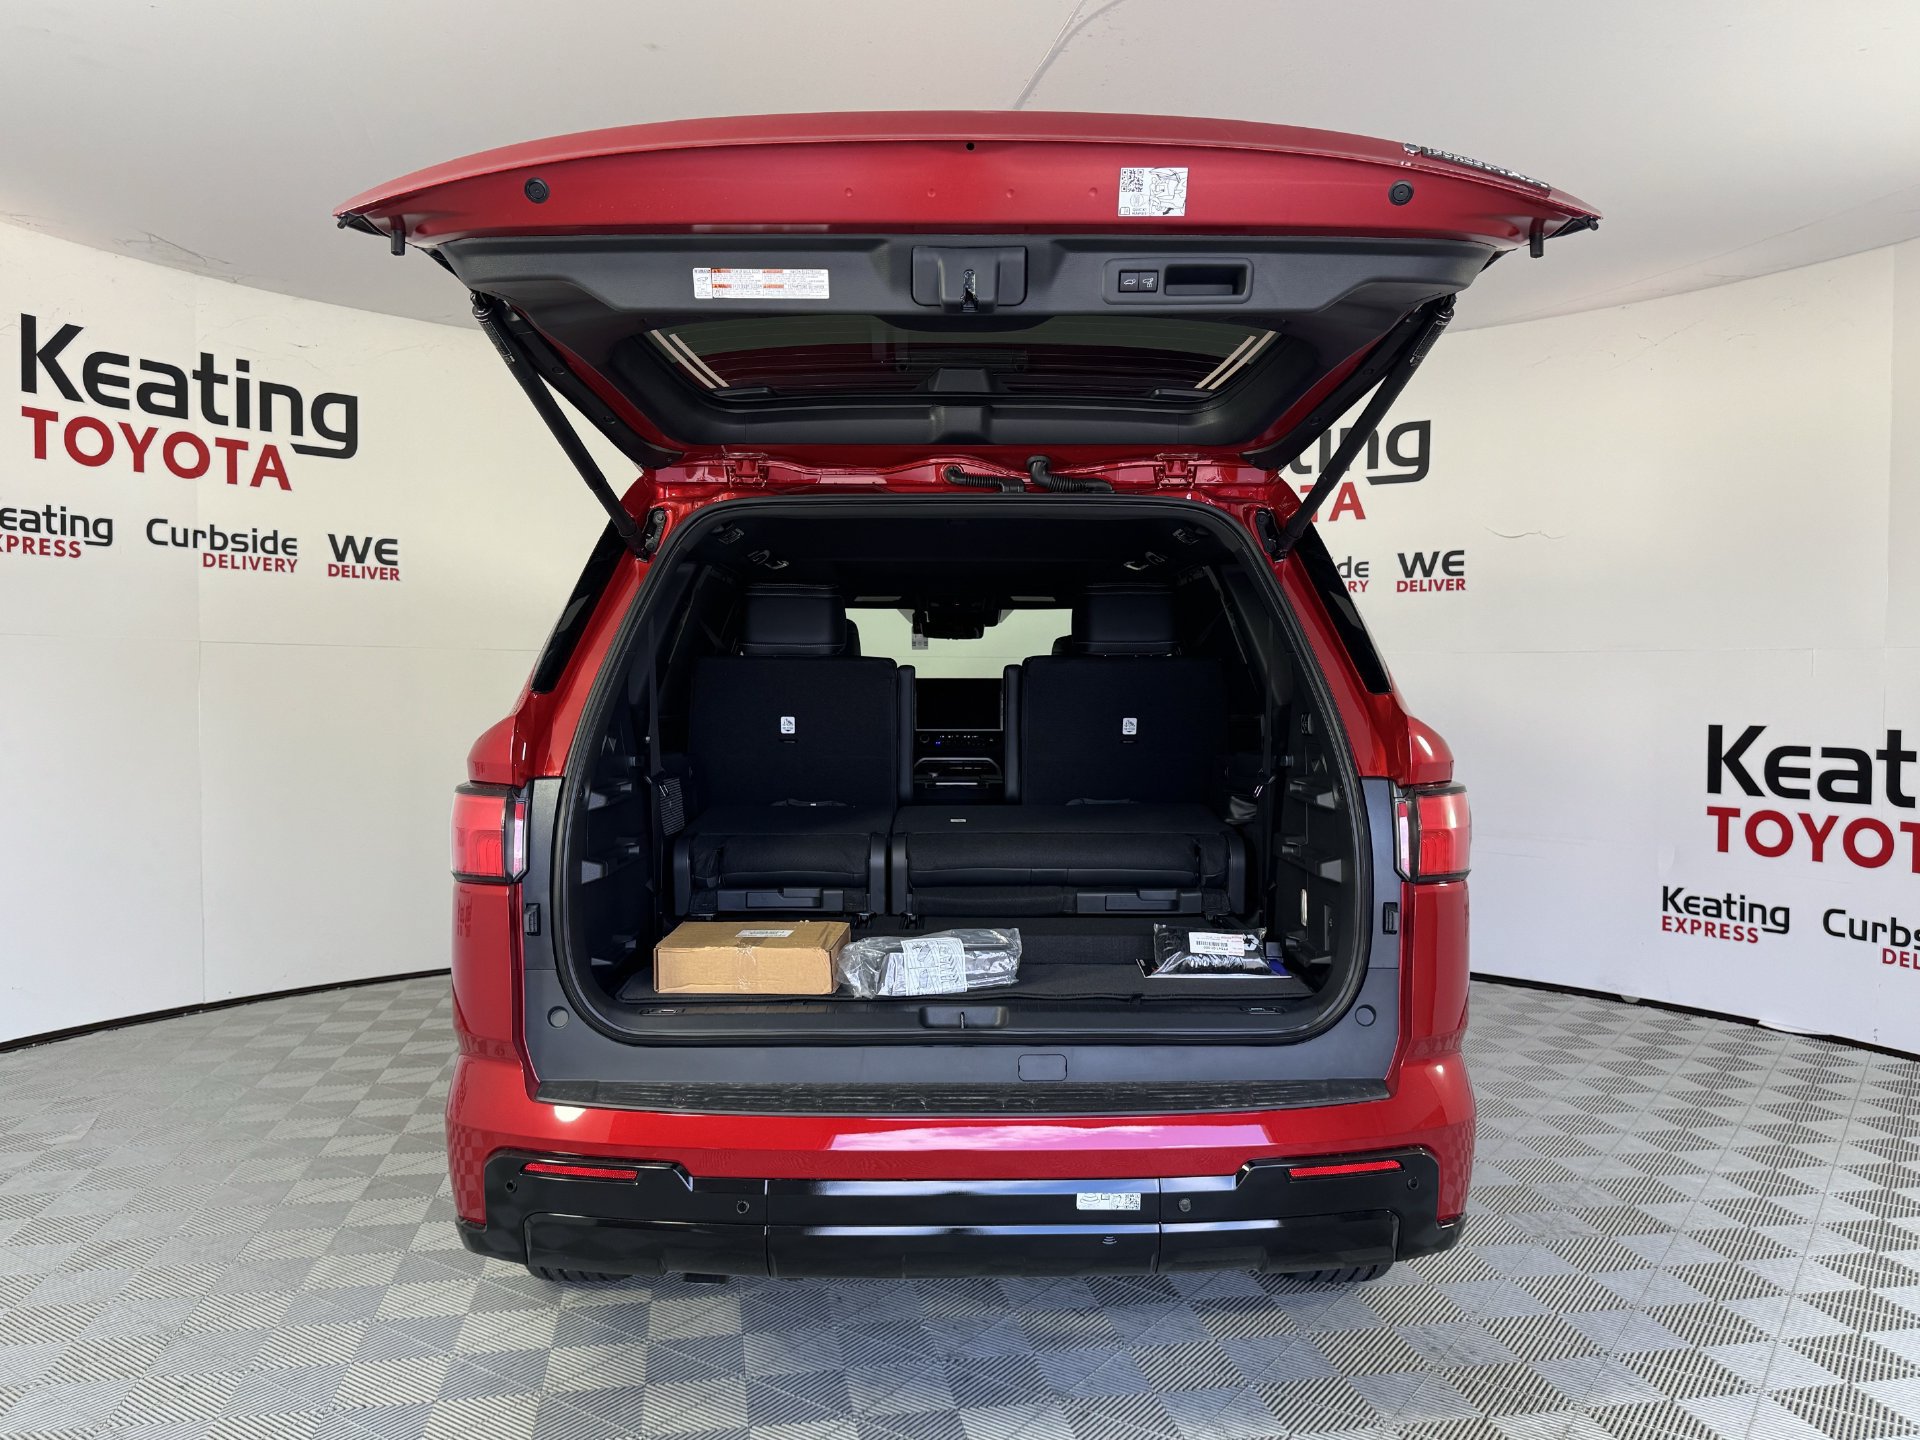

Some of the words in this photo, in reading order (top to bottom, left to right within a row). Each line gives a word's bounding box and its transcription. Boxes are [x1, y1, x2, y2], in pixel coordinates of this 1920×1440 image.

[20, 312, 358, 460] Keating
[20, 405, 292, 492] TOYOTA
[146, 518, 298, 557] Curbside
[202, 553, 298, 573] DELIVERY
[327, 563, 401, 581] DELIVER
[1396, 578, 1467, 593] DELIVER
[1706, 724, 1918, 809] Keat
[1706, 805, 1920, 874] TOYOT
[1661, 914, 1759, 944] EXPRESS
[1662, 885, 1790, 935] Keating
